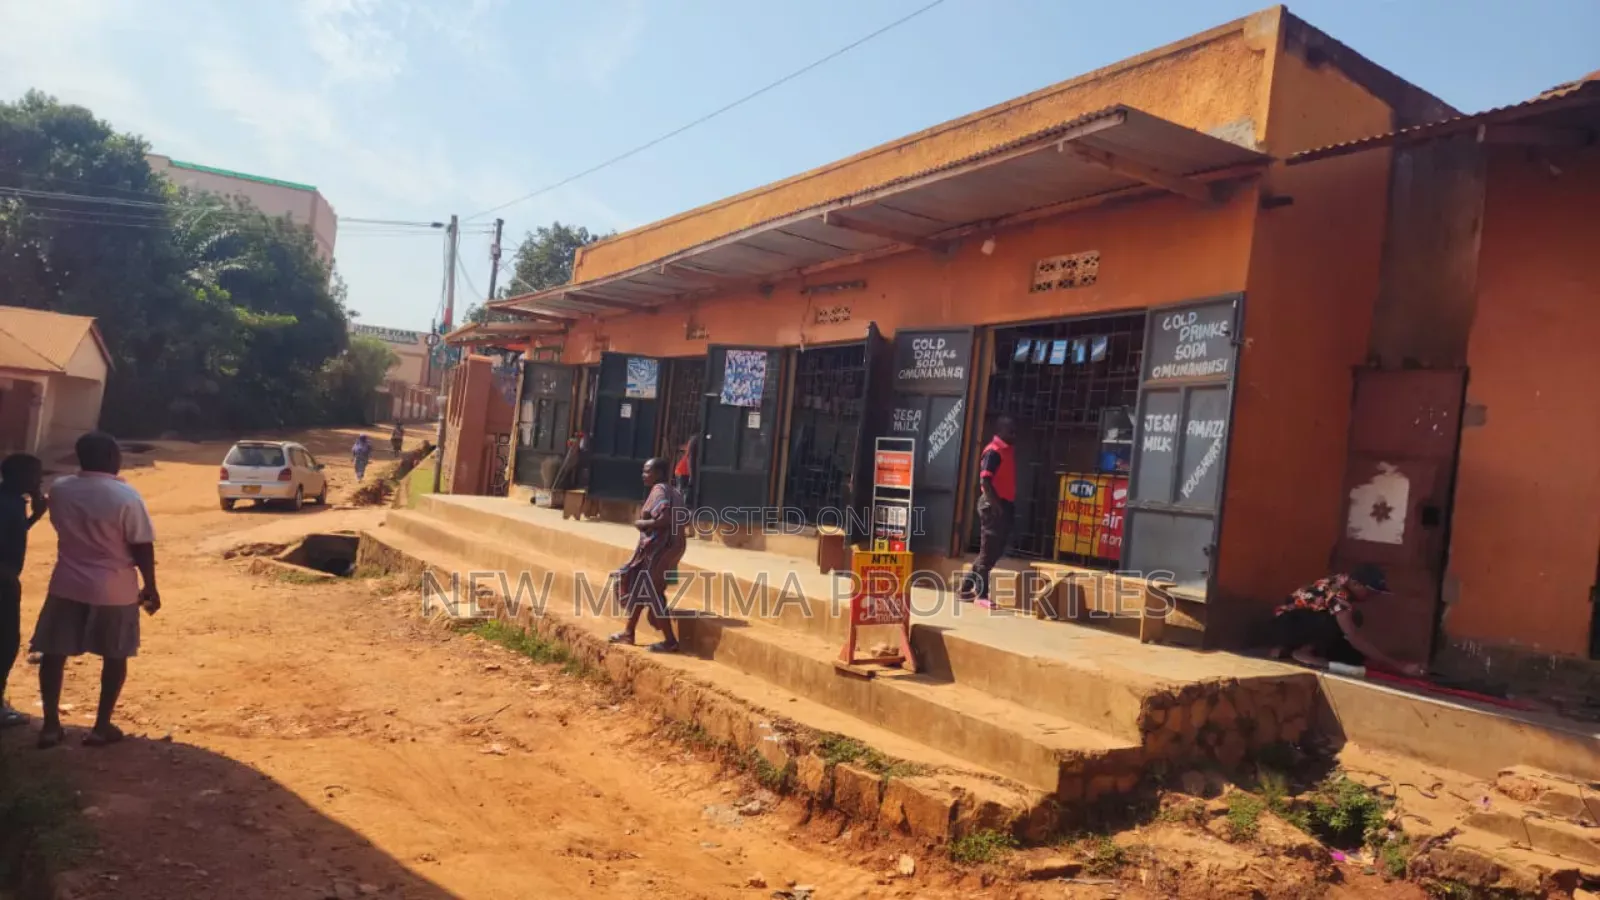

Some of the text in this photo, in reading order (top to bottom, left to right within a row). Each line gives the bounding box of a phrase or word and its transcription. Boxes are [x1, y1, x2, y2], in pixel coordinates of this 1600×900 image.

[1162, 312, 1198, 331] COLD
[1174, 341, 1207, 361] SODA
[916, 359, 944, 368] SODA
[893, 408, 921, 421] JESA
[893, 420, 919, 432] MILK
[1144, 413, 1178, 432] JESA
[1143, 436, 1172, 452] MILK
[1070, 483, 1094, 496] MTN
[871, 553, 898, 565] MTN
